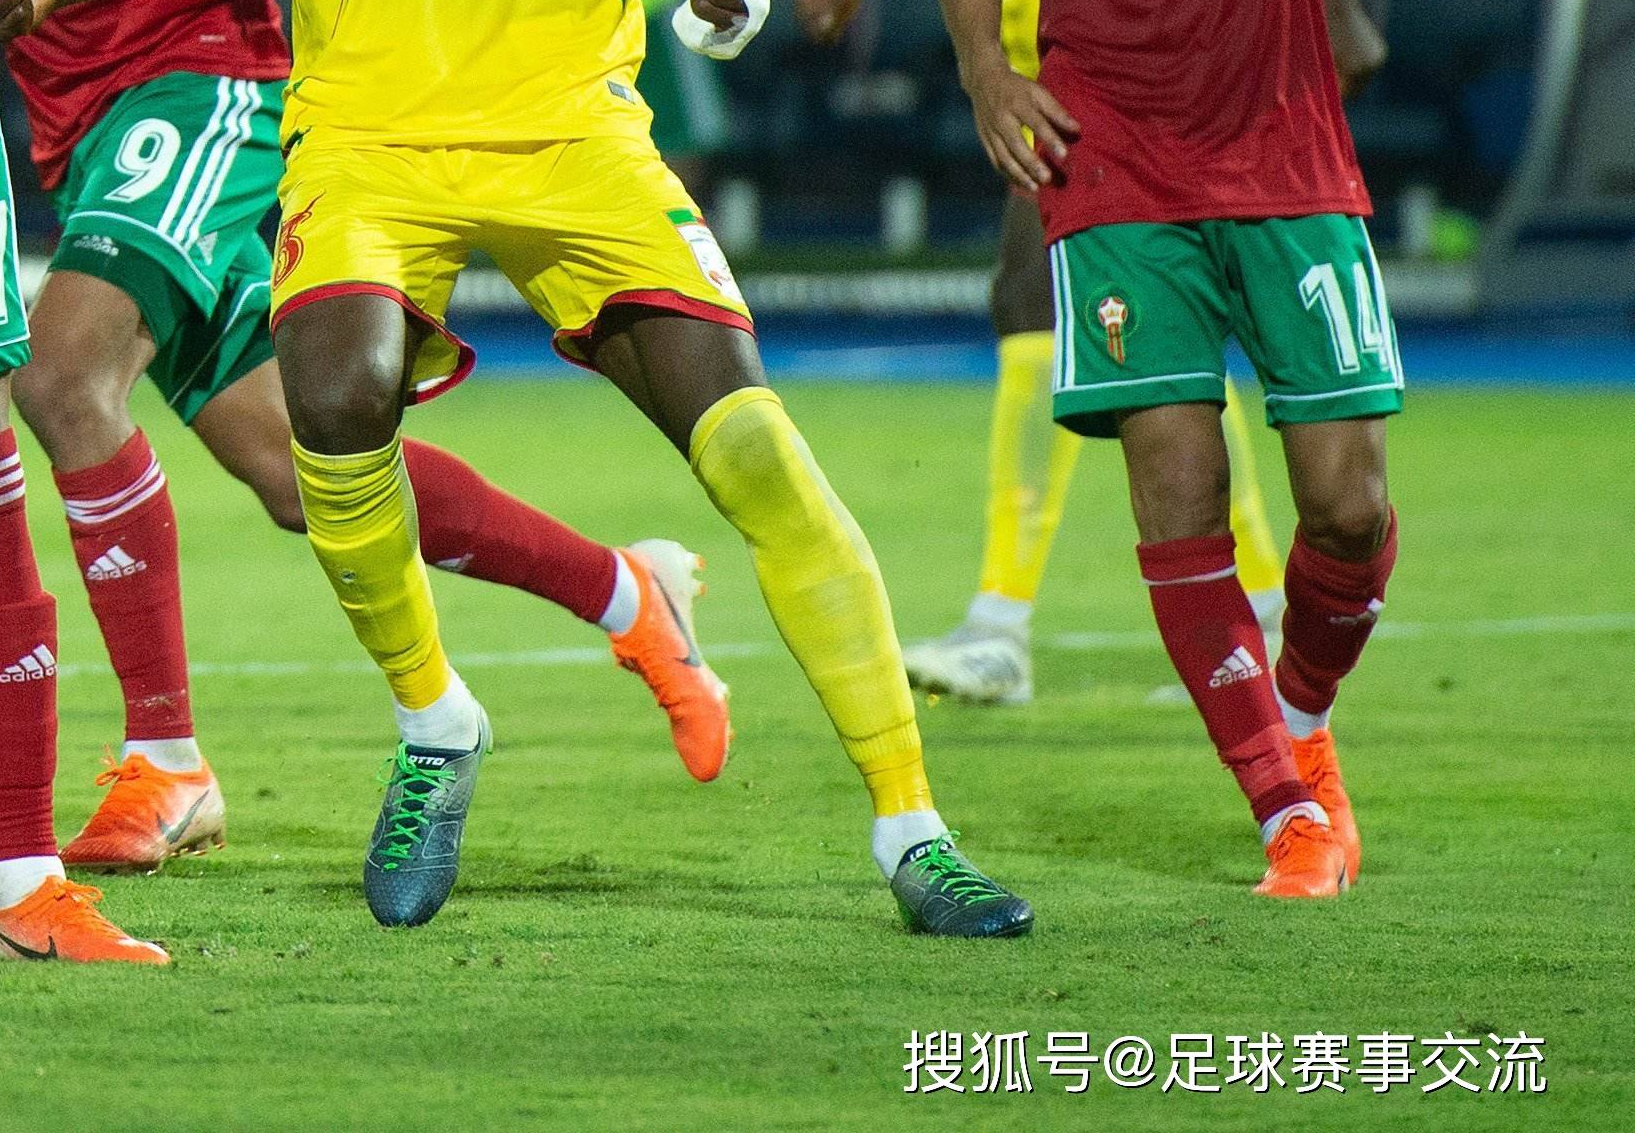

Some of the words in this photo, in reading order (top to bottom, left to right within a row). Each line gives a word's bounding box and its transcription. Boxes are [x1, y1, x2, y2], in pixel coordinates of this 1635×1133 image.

[103, 118, 181, 203] 9
[1298, 262, 1391, 376] 14
[86, 559, 148, 580] adidas
[1208, 665, 1263, 687] adidas
